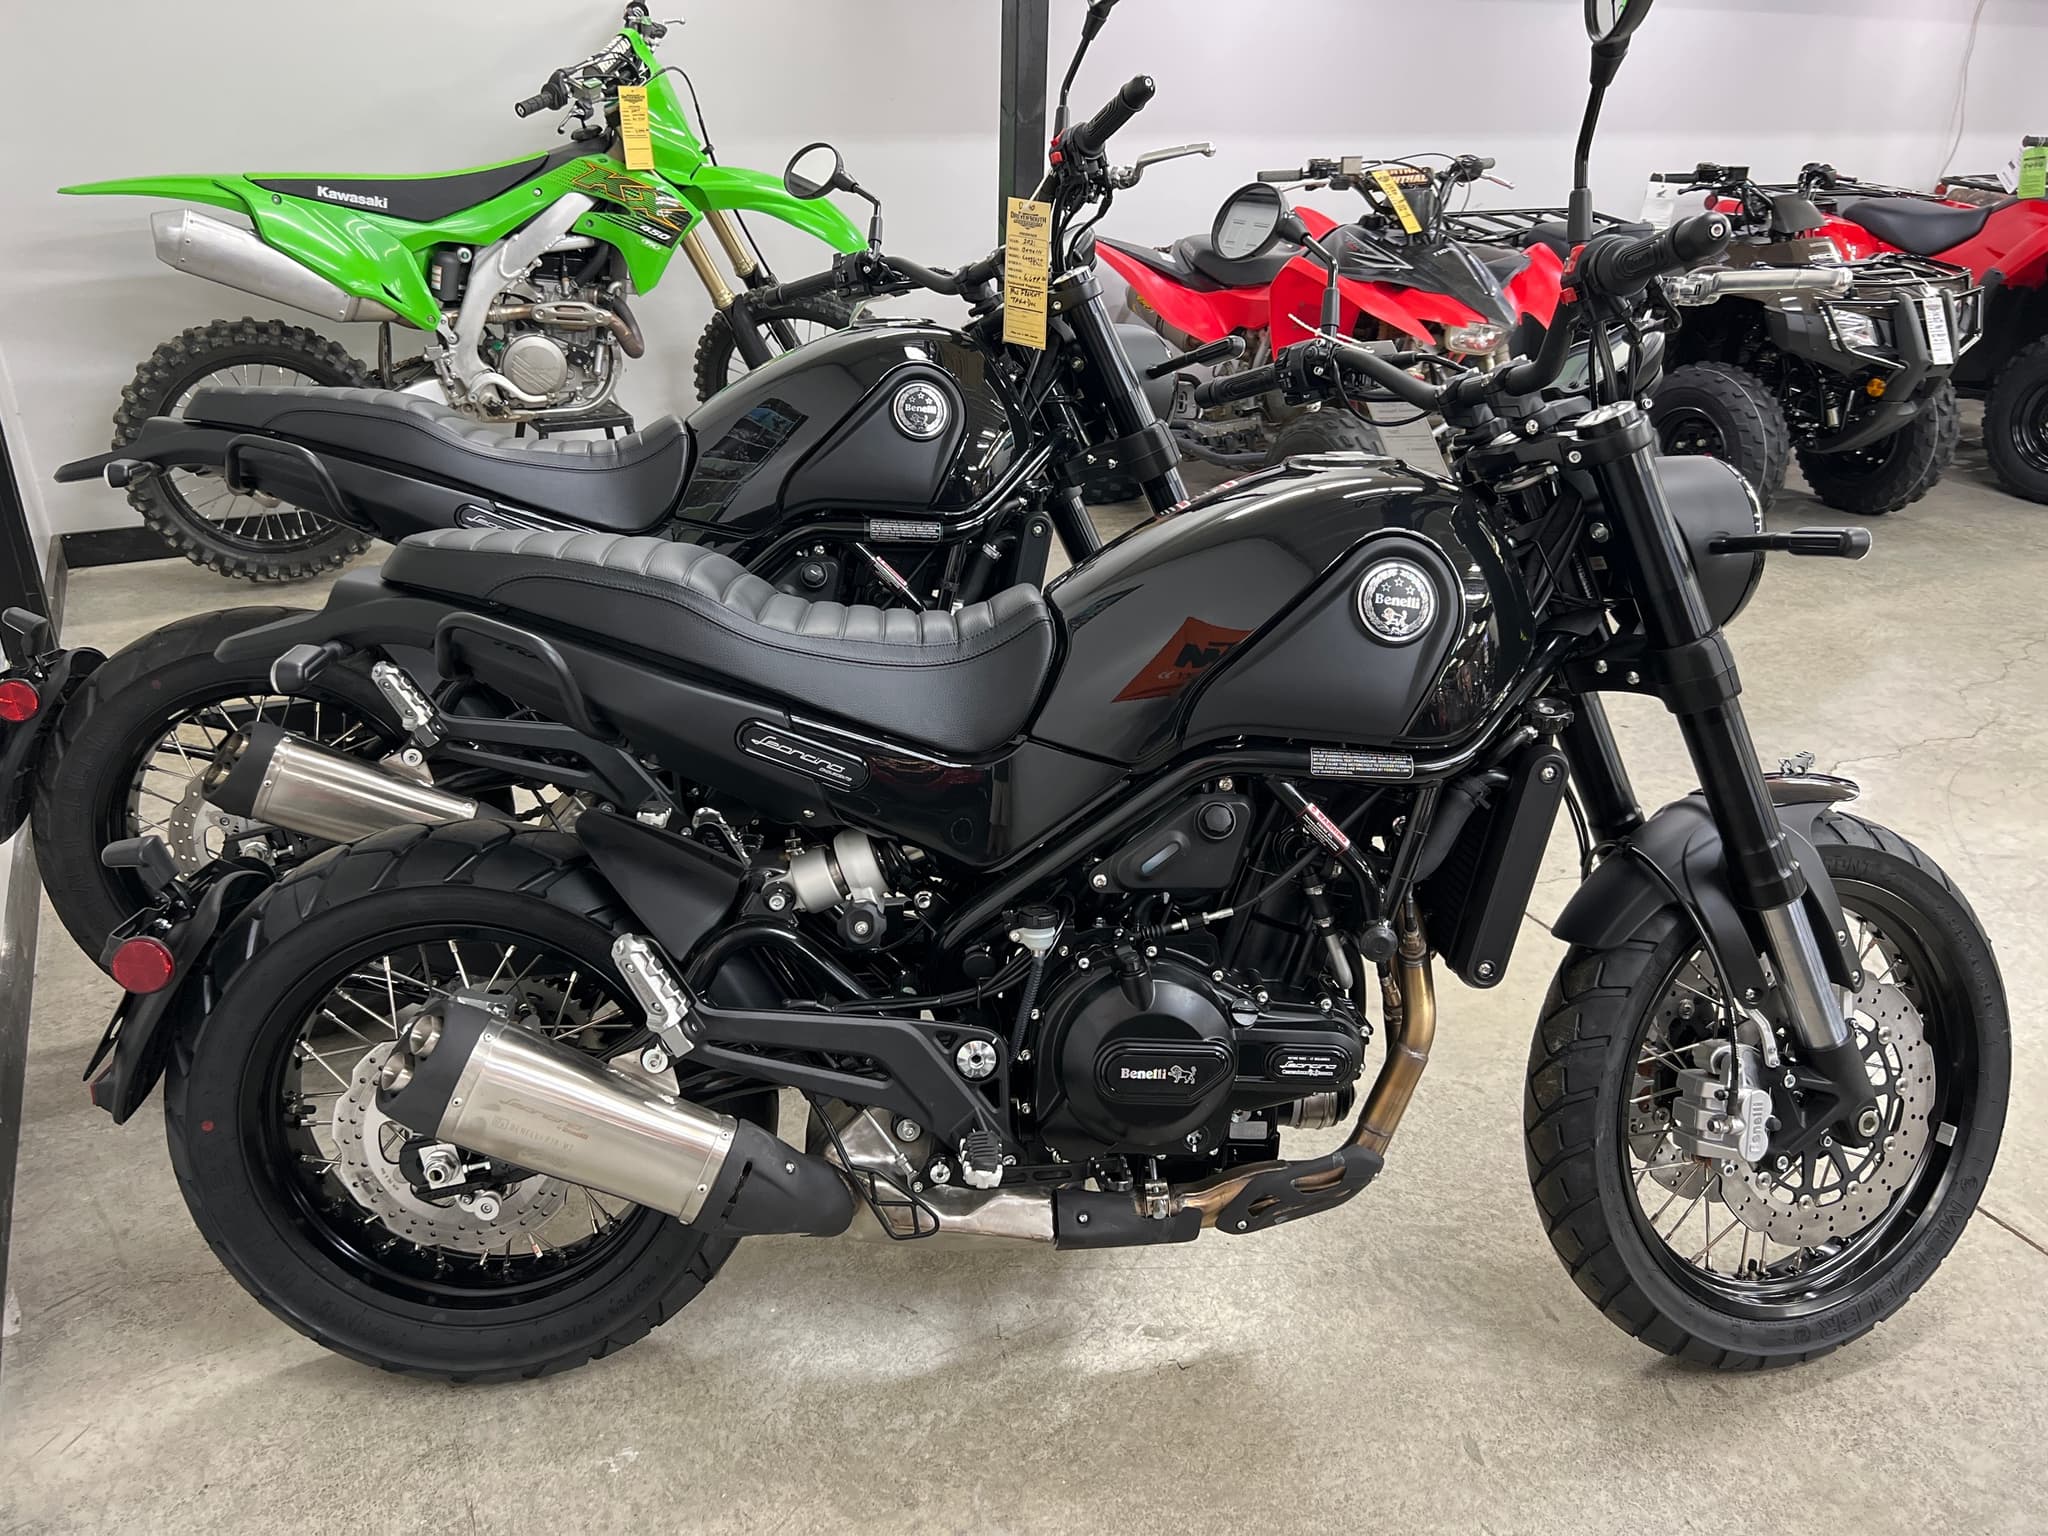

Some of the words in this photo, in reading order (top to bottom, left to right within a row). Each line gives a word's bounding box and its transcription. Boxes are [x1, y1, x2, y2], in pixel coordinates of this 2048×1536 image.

[317, 185, 388, 208] Kawasaki
[639, 224, 672, 240] 450
[905, 403, 937, 415] Benelli
[1374, 593, 1421, 609] Benelli
[751, 735, 846, 773] Leoncino
[1120, 1067, 1167, 1079] Benelli
[1749, 1102, 1763, 1153] Benelli
